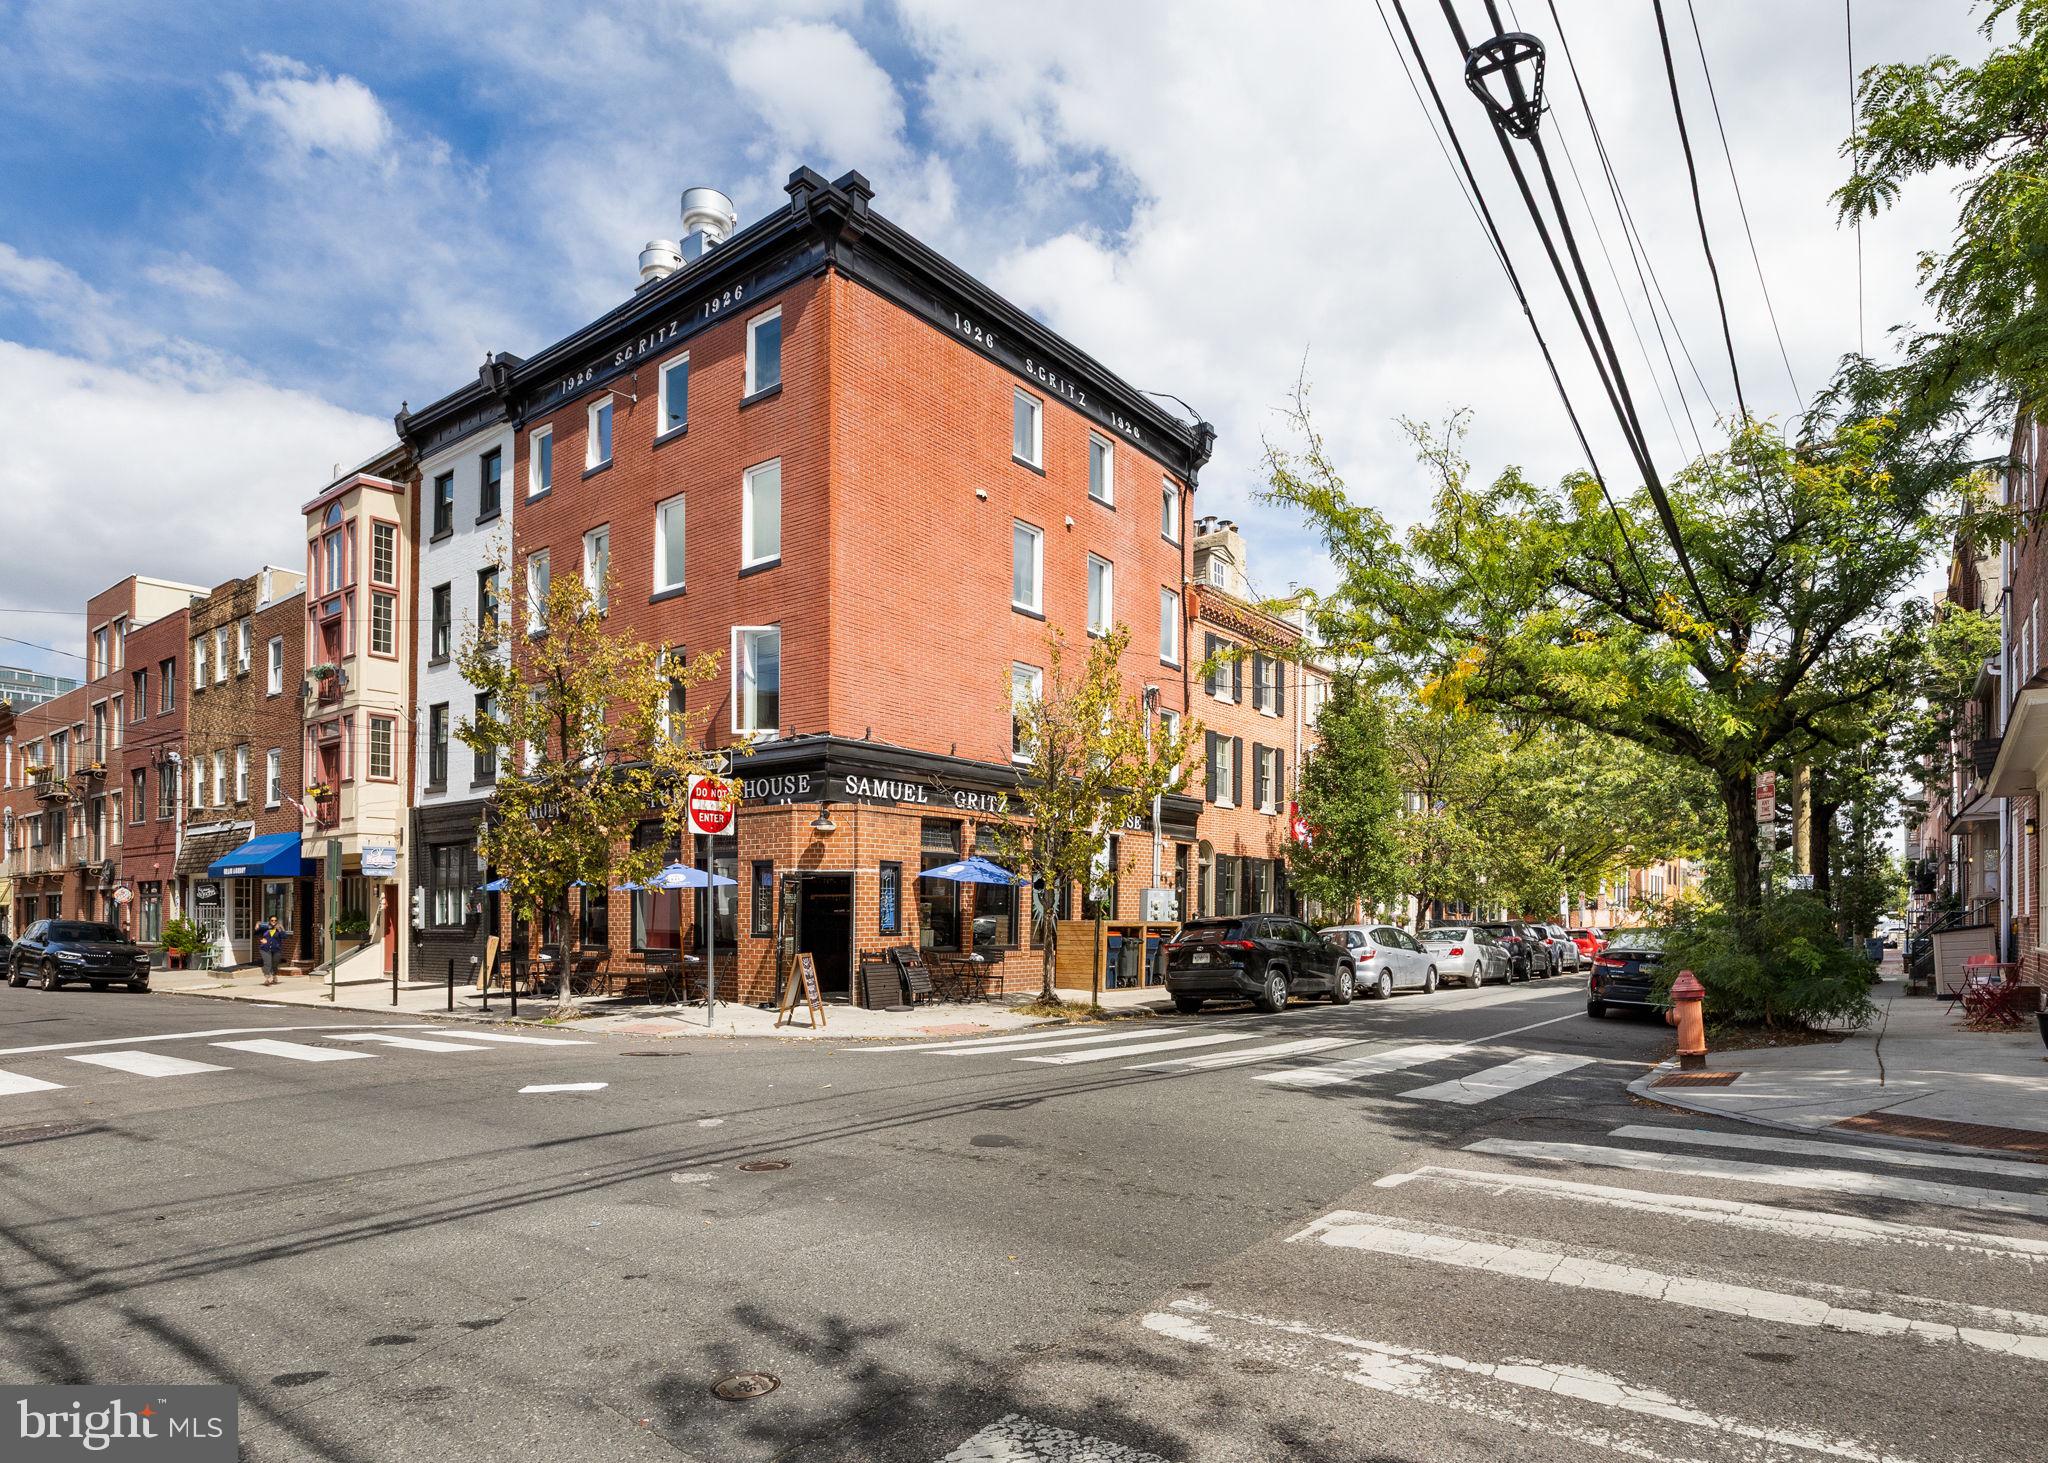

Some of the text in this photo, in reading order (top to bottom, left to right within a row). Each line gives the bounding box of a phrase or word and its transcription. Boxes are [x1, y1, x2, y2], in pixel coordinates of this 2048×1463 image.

[562, 368, 593, 395] 1926
[704, 285, 743, 318] 1926
[954, 312, 994, 349] 1926
[1111, 411, 1140, 439] 1926
[696, 787, 708, 798] DO
[711, 788, 728, 799] NOT
[743, 774, 811, 799] HOUSE
[845, 775, 928, 804] SAMUEL
[699, 813, 725, 823] ENTER
